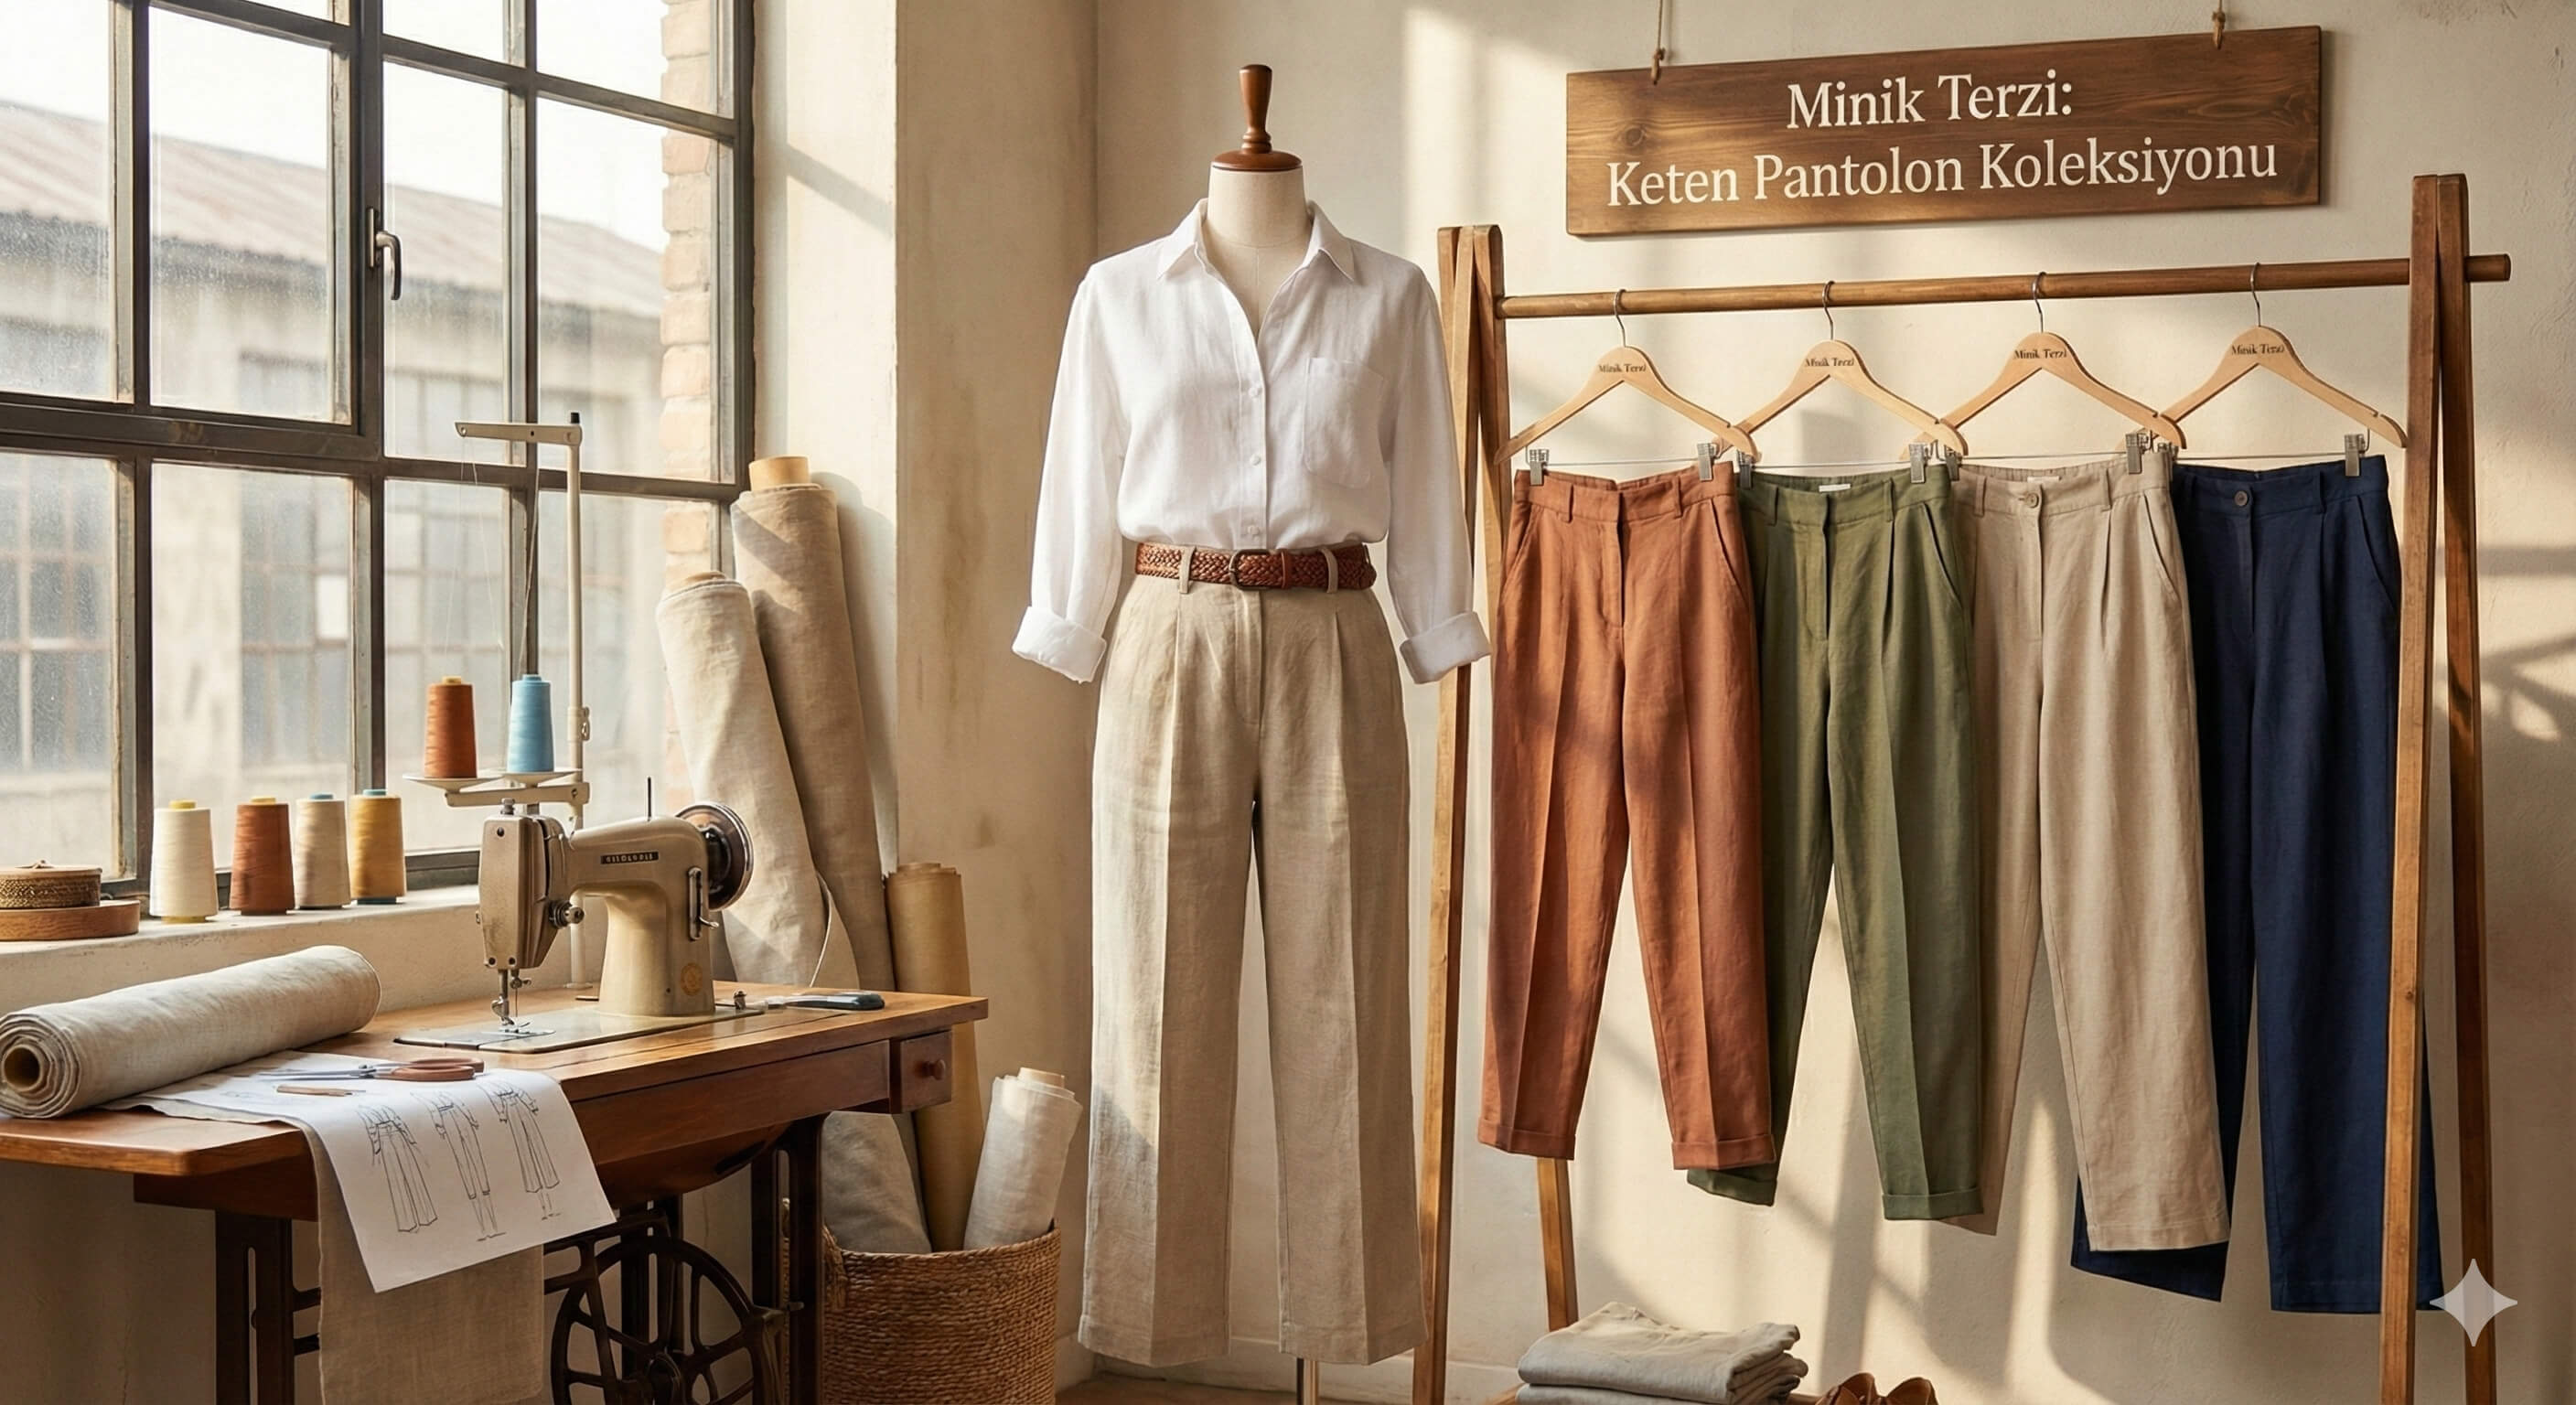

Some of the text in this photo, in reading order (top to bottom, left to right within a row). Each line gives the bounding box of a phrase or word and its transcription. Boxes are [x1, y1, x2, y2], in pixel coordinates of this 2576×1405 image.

[1787, 70, 2073, 129] Minik Terzi:
[1606, 137, 2278, 206] Keten Pantolon Koleksiyonu
